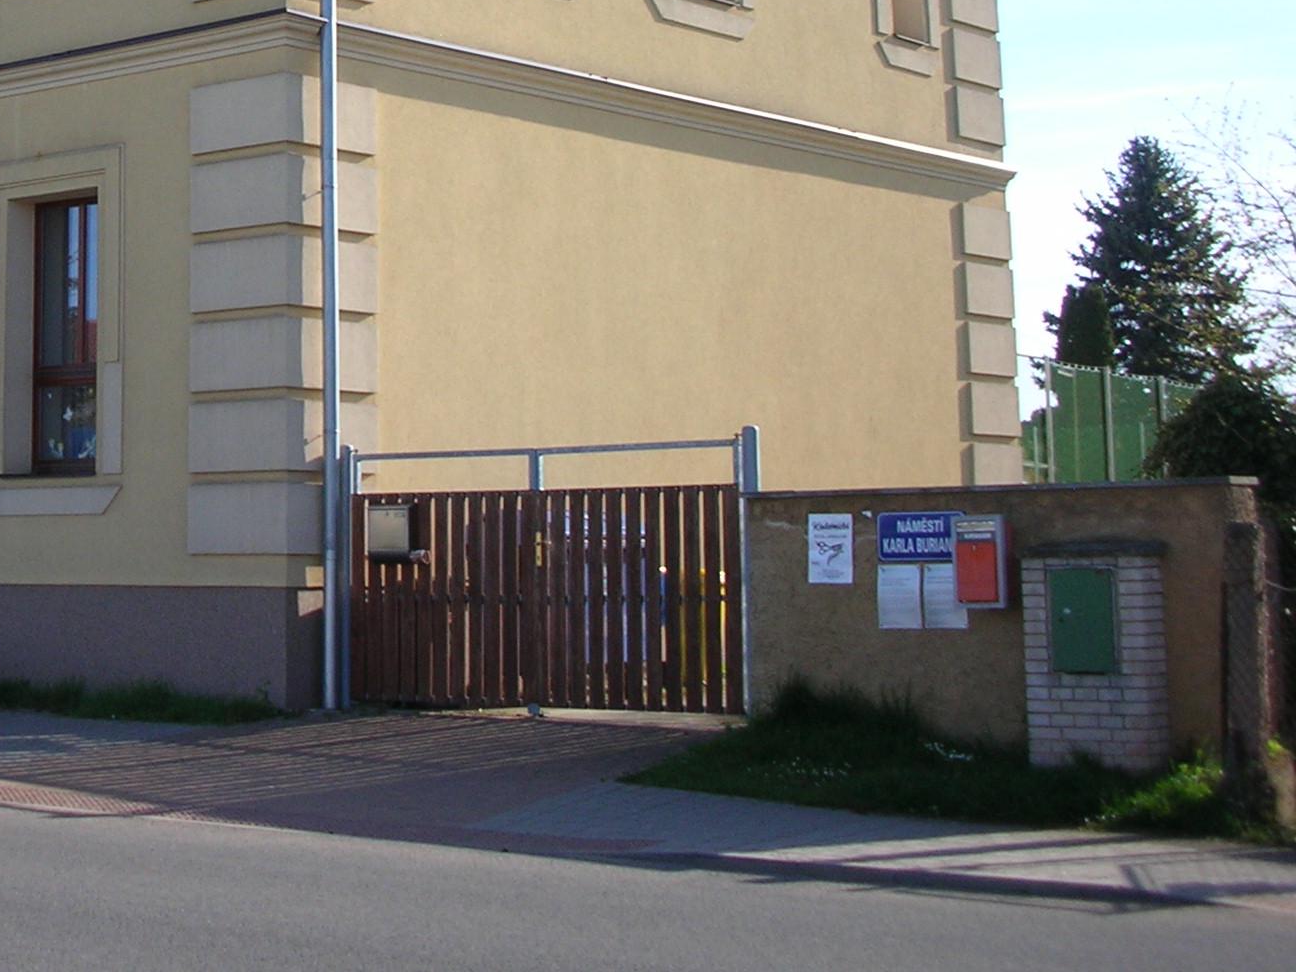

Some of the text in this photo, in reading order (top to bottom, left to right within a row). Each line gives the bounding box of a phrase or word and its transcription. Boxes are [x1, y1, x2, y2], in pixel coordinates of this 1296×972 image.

[896, 516, 944, 533] NÁMĚSTÍ
[882, 537, 953, 553] KARLA BURIAN
